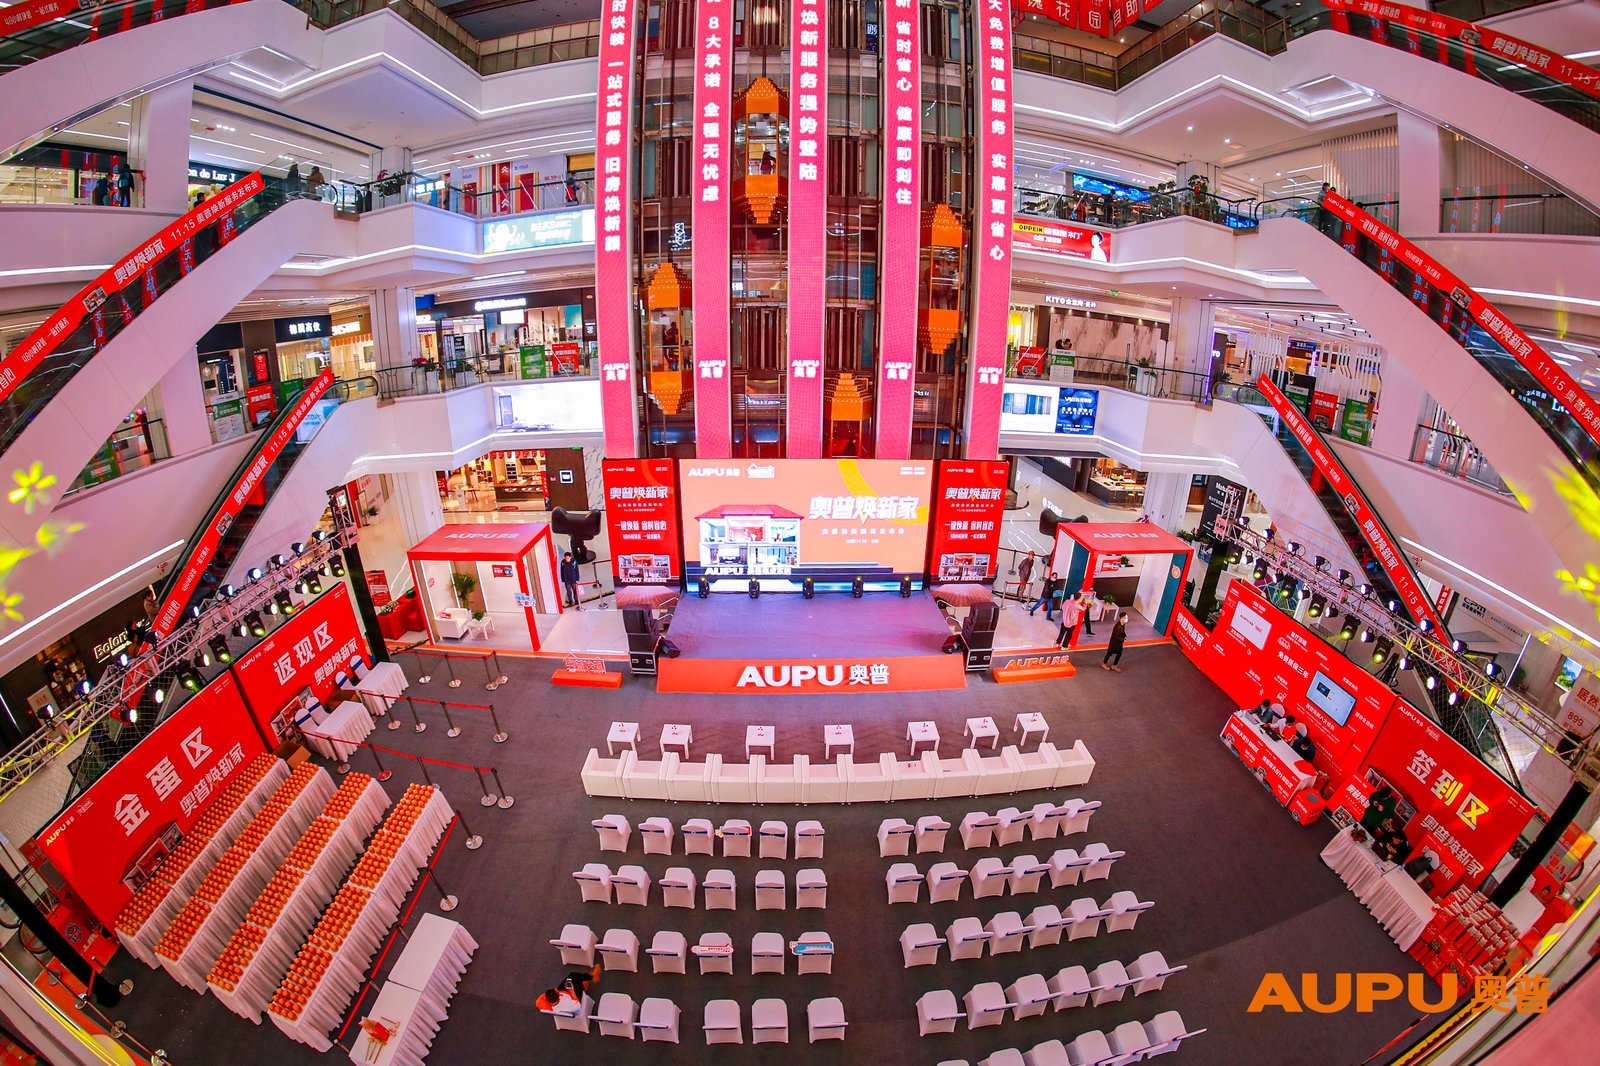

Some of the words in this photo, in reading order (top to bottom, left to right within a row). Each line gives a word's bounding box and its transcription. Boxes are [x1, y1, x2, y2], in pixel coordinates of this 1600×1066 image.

[703, 16, 722, 88] 8大承诺
[896, 21, 912, 91] 省时省心
[1492, 37, 1551, 69] 奥普焕新家
[605, 61, 624, 146] 一站式服务
[702, 102, 720, 202] 全程无忧虑
[895, 105, 913, 205] 健康即刻住
[199, 170, 210, 179] de
[604, 156, 621, 252] 旧房焕新颜
[989, 153, 1006, 261] 实惠更省心
[114, 238, 166, 285] 奥普焕新家
[171, 219, 196, 240] 11.15
[196, 179, 259, 225] 奥普焕新服务发布会
[1019, 224, 1043, 233] OPPEIN
[1045, 295, 1065, 304] KITO
[1479, 308, 1533, 359] 奥普焕新家
[1538, 361, 1566, 391] 11.15
[270, 430, 287, 452] 11.15
[688, 467, 724, 477] AUPU
[610, 486, 669, 500] 奥普焕新家
[945, 487, 1002, 501] 奥普焕新家
[808, 495, 919, 522] 奥普焕新家
[704, 567, 744, 576] AUPU
[1399, 576, 1418, 605] 11.15
[240, 656, 256, 671] AUPU
[273, 621, 334, 686] 返现区
[314, 637, 358, 685] 奥普焕新家
[1005, 656, 1052, 669] AUPU
[736, 665, 844, 687] AUPU
[849, 664, 889, 685] 奥普
[1399, 705, 1418, 722] AUPU
[1567, 711, 1584, 727] 899
[114, 726, 213, 837] 金蛋区
[179, 742, 246, 818] 奥普焕新家
[1406, 749, 1490, 831] 签到区
[45, 825, 66, 846] AUPU
[1420, 814, 1485, 879] 奥普焕新家
